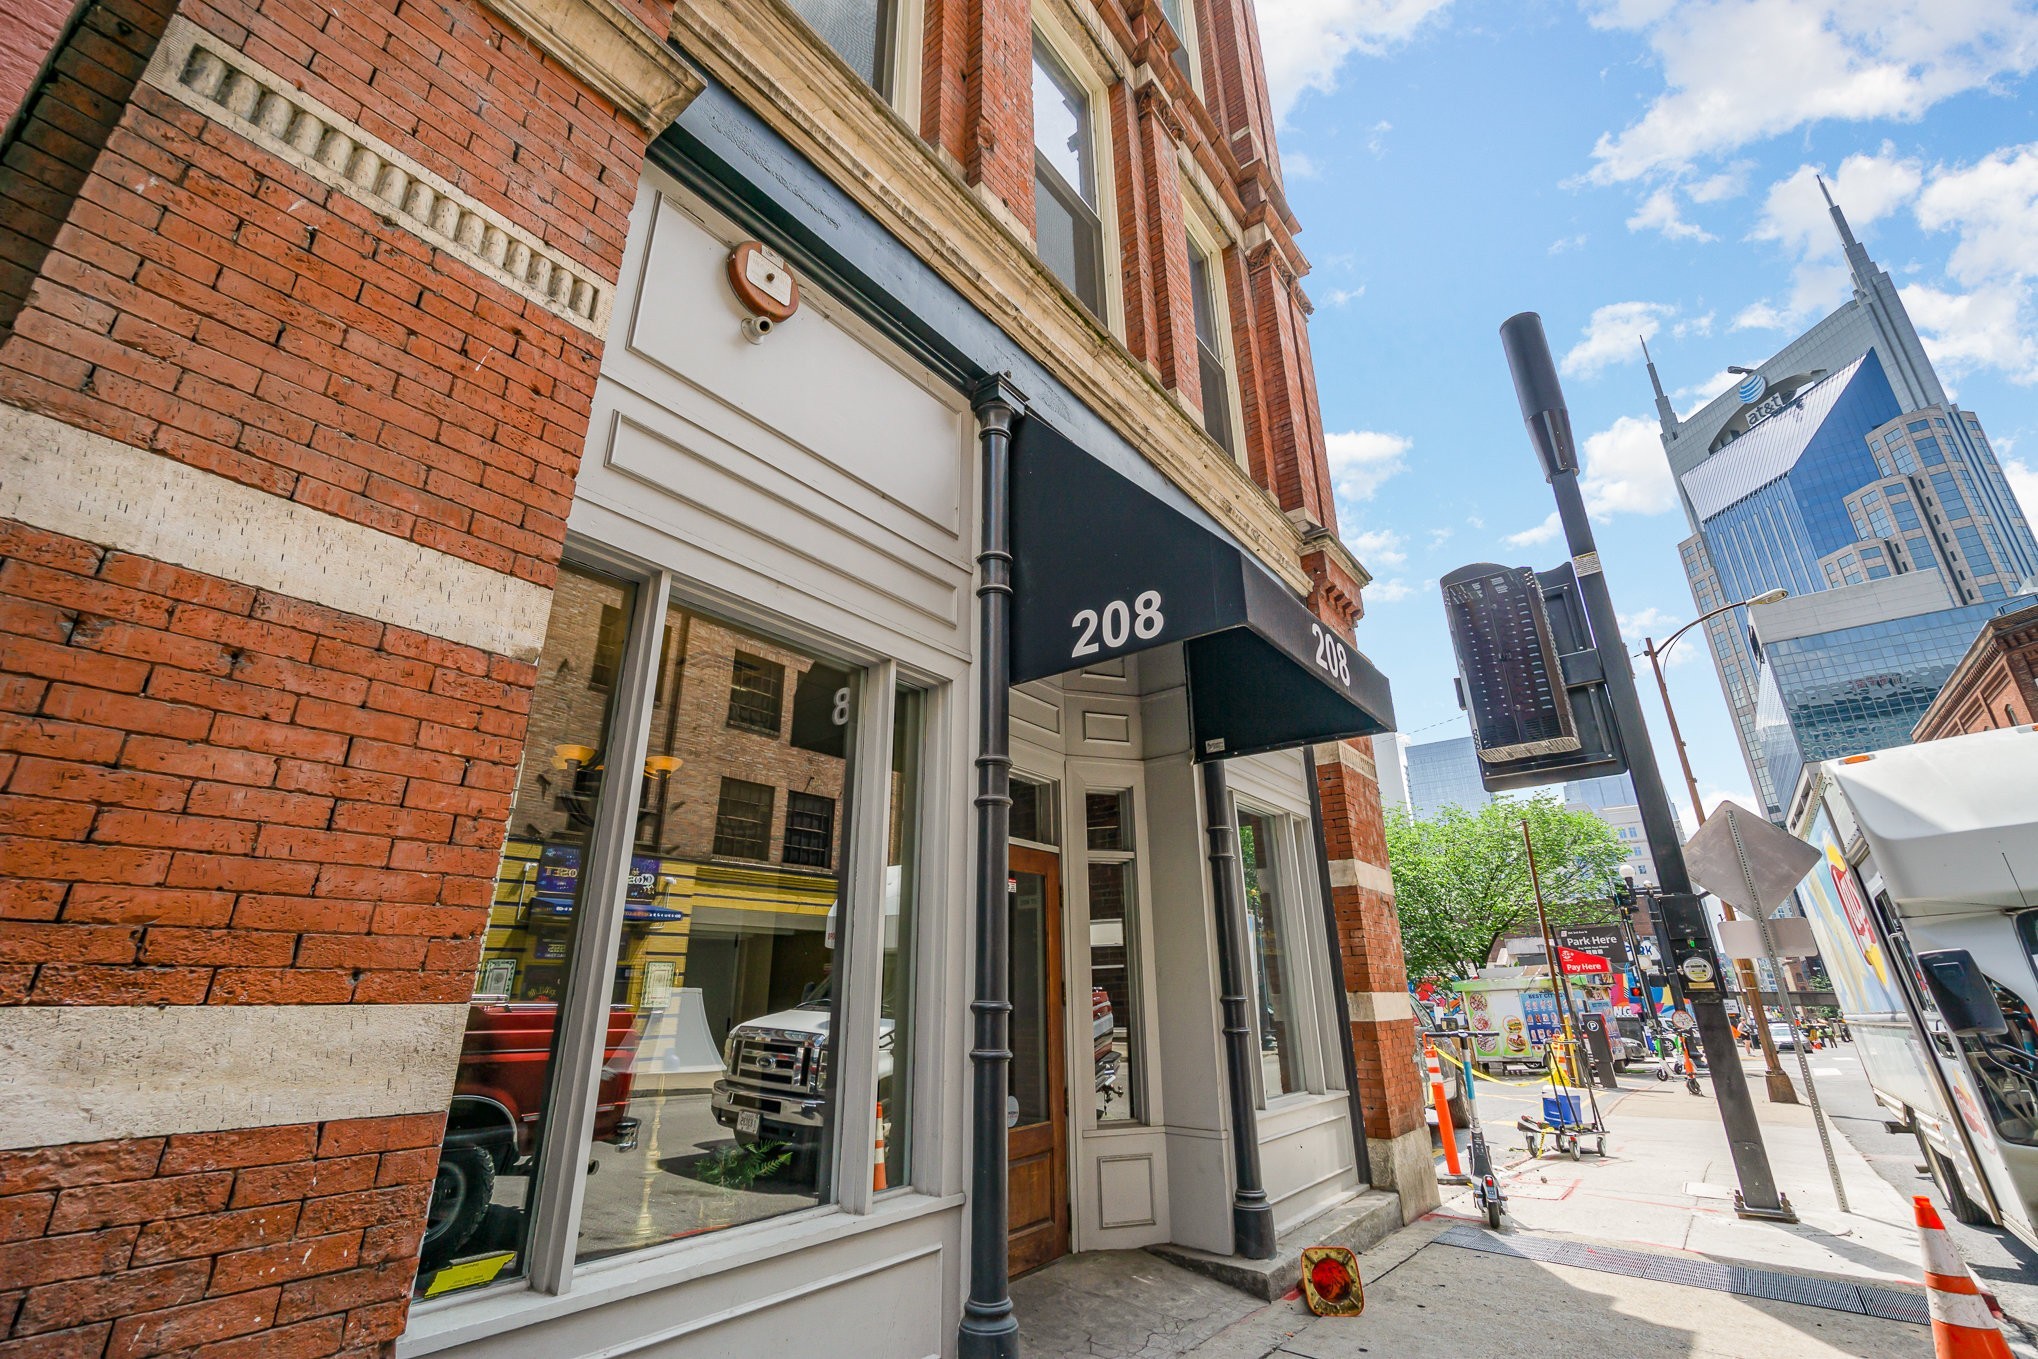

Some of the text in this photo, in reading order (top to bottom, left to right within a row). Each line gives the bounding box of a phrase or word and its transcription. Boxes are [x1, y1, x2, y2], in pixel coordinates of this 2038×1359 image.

[1748, 395, 1781, 425] at&t
[1072, 590, 1164, 658] 208
[1312, 623, 1350, 686] 208
[1567, 936, 1617, 946] Park Here
[1566, 964, 1580, 972] Pay
